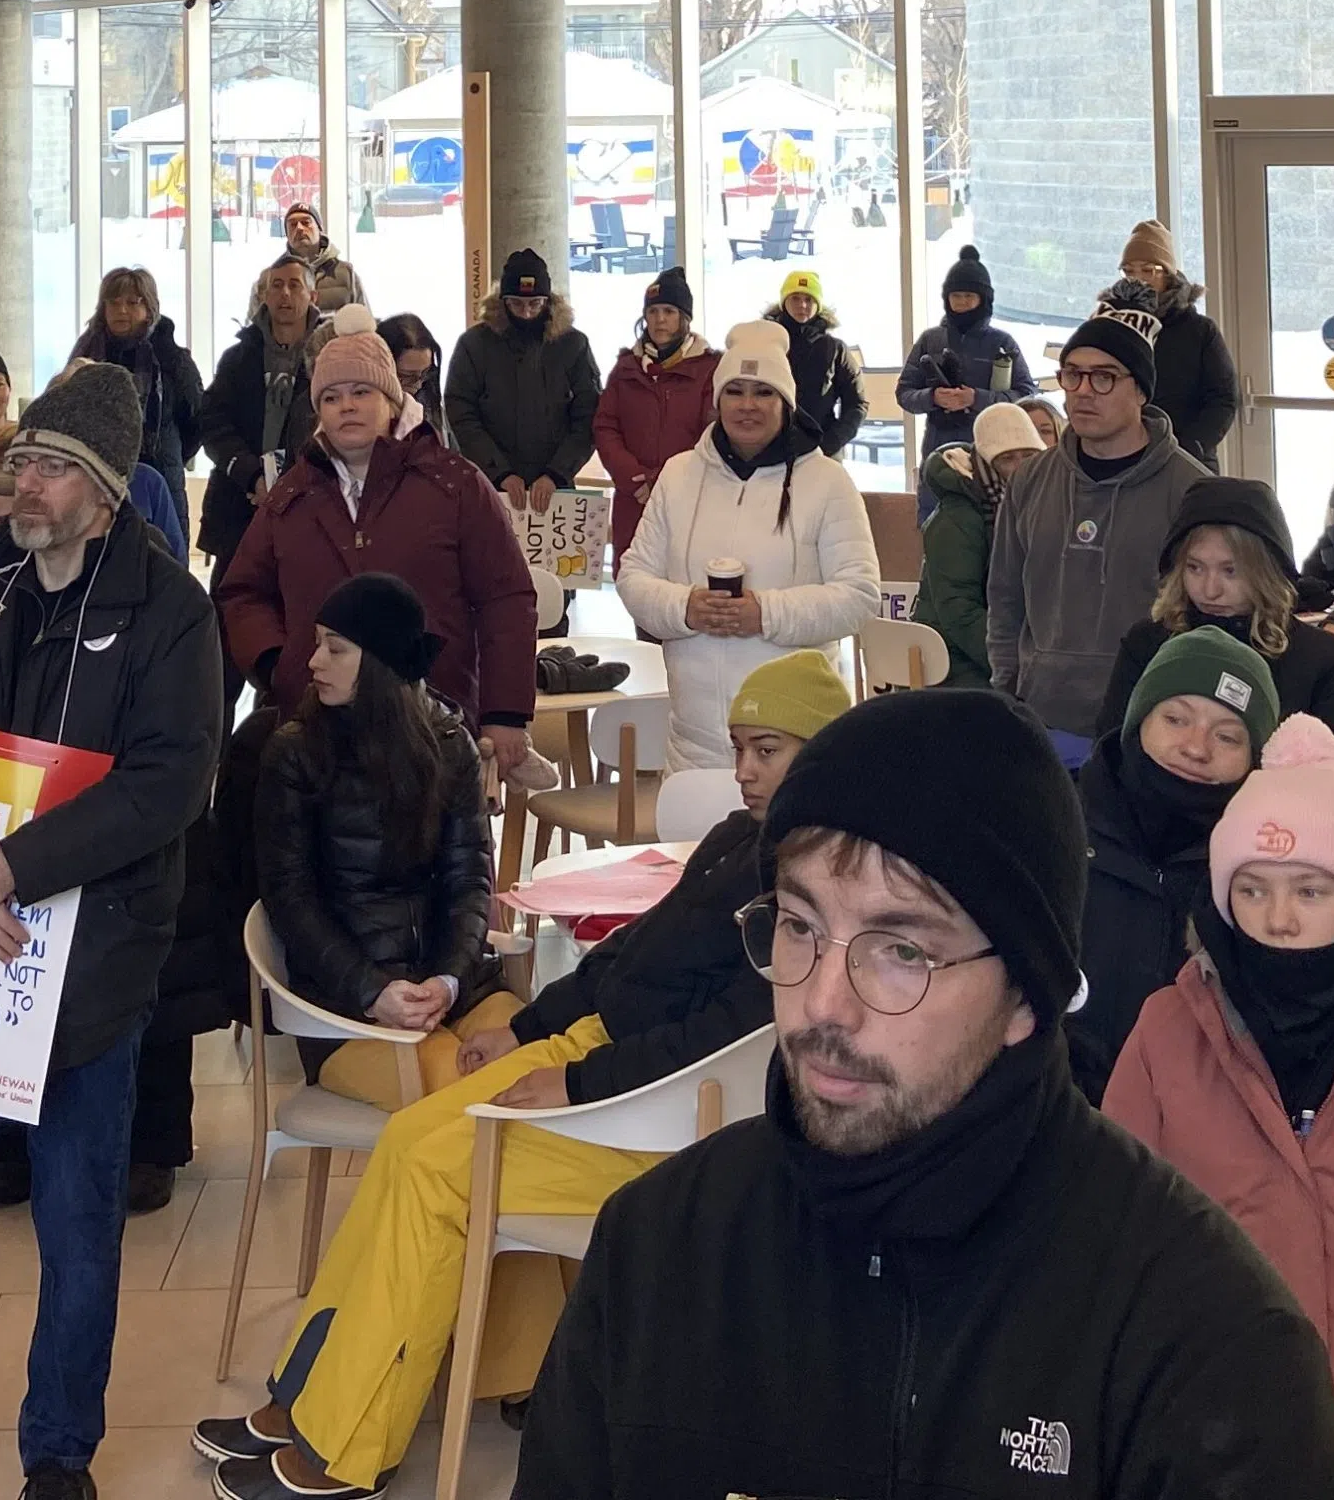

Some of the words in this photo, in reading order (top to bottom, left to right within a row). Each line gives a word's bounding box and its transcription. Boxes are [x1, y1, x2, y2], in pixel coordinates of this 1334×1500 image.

[472, 248, 481, 299] CANADA
[526, 514, 543, 565] NOT
[571, 496, 588, 546] CALLS
[4, 961, 47, 989] NOT
[7, 988, 35, 1012] TO
[9, 1091, 34, 1106] Union
